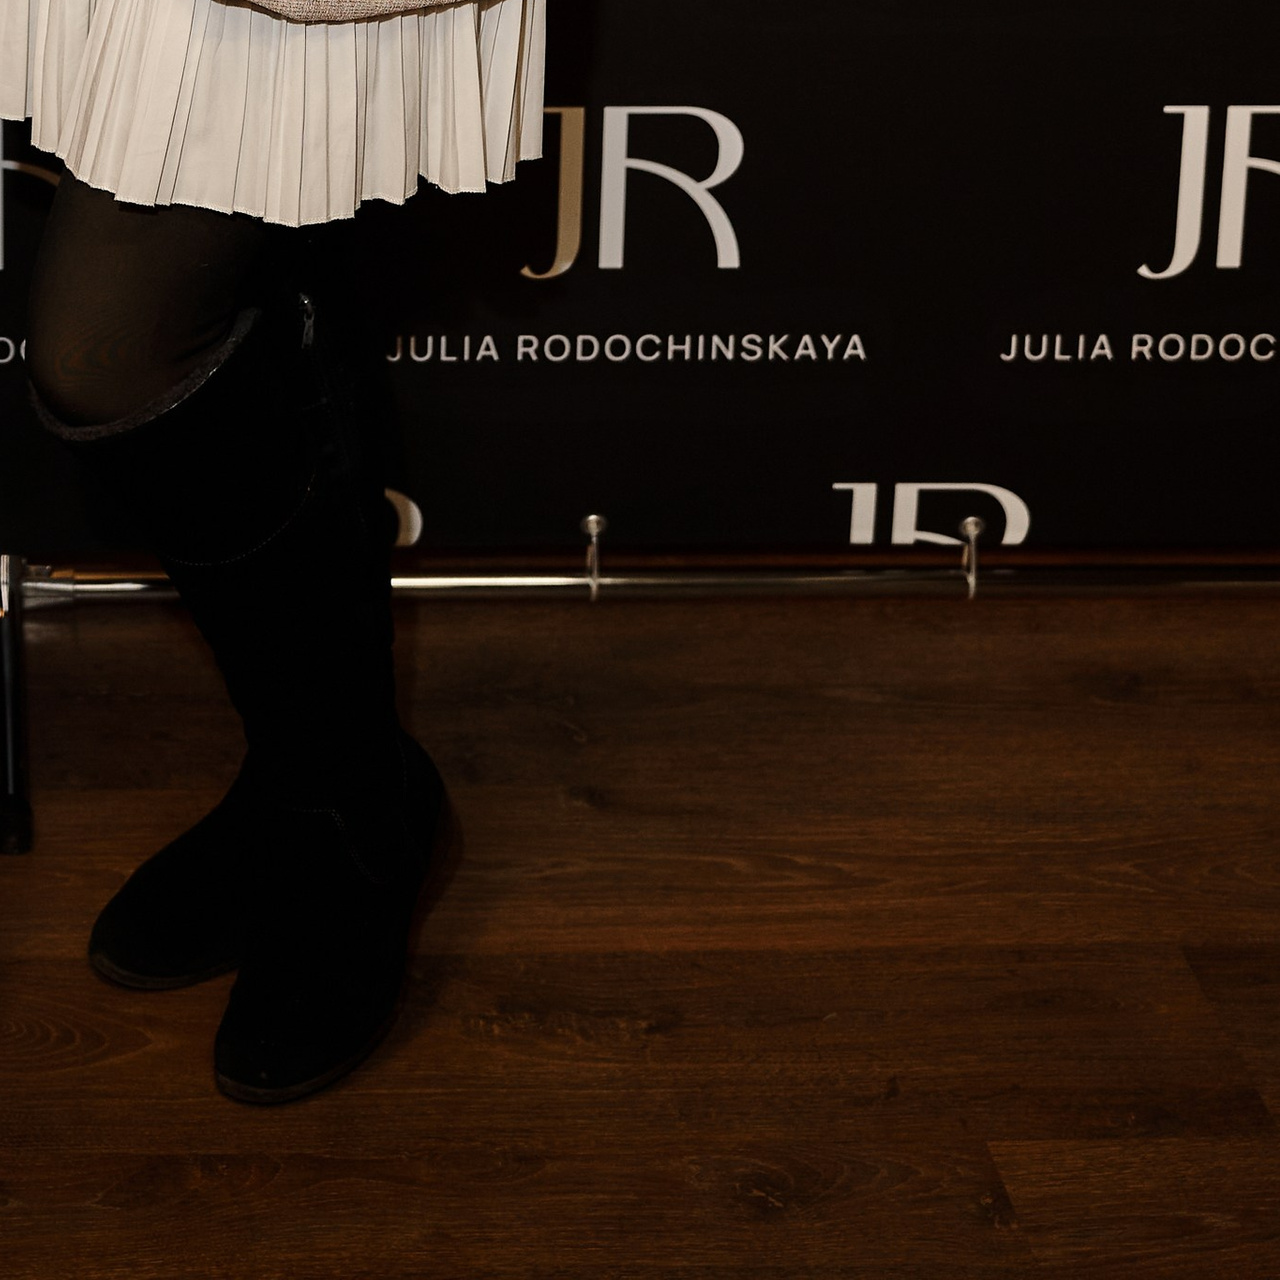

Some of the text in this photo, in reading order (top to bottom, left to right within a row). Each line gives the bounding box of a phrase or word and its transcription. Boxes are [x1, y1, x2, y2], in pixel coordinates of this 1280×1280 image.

[521, 106, 744, 279] JR
[387, 334, 866, 362] JULIA RODOCHINSKAYA
[1000, 333, 1276, 361] JULIA RODOC
